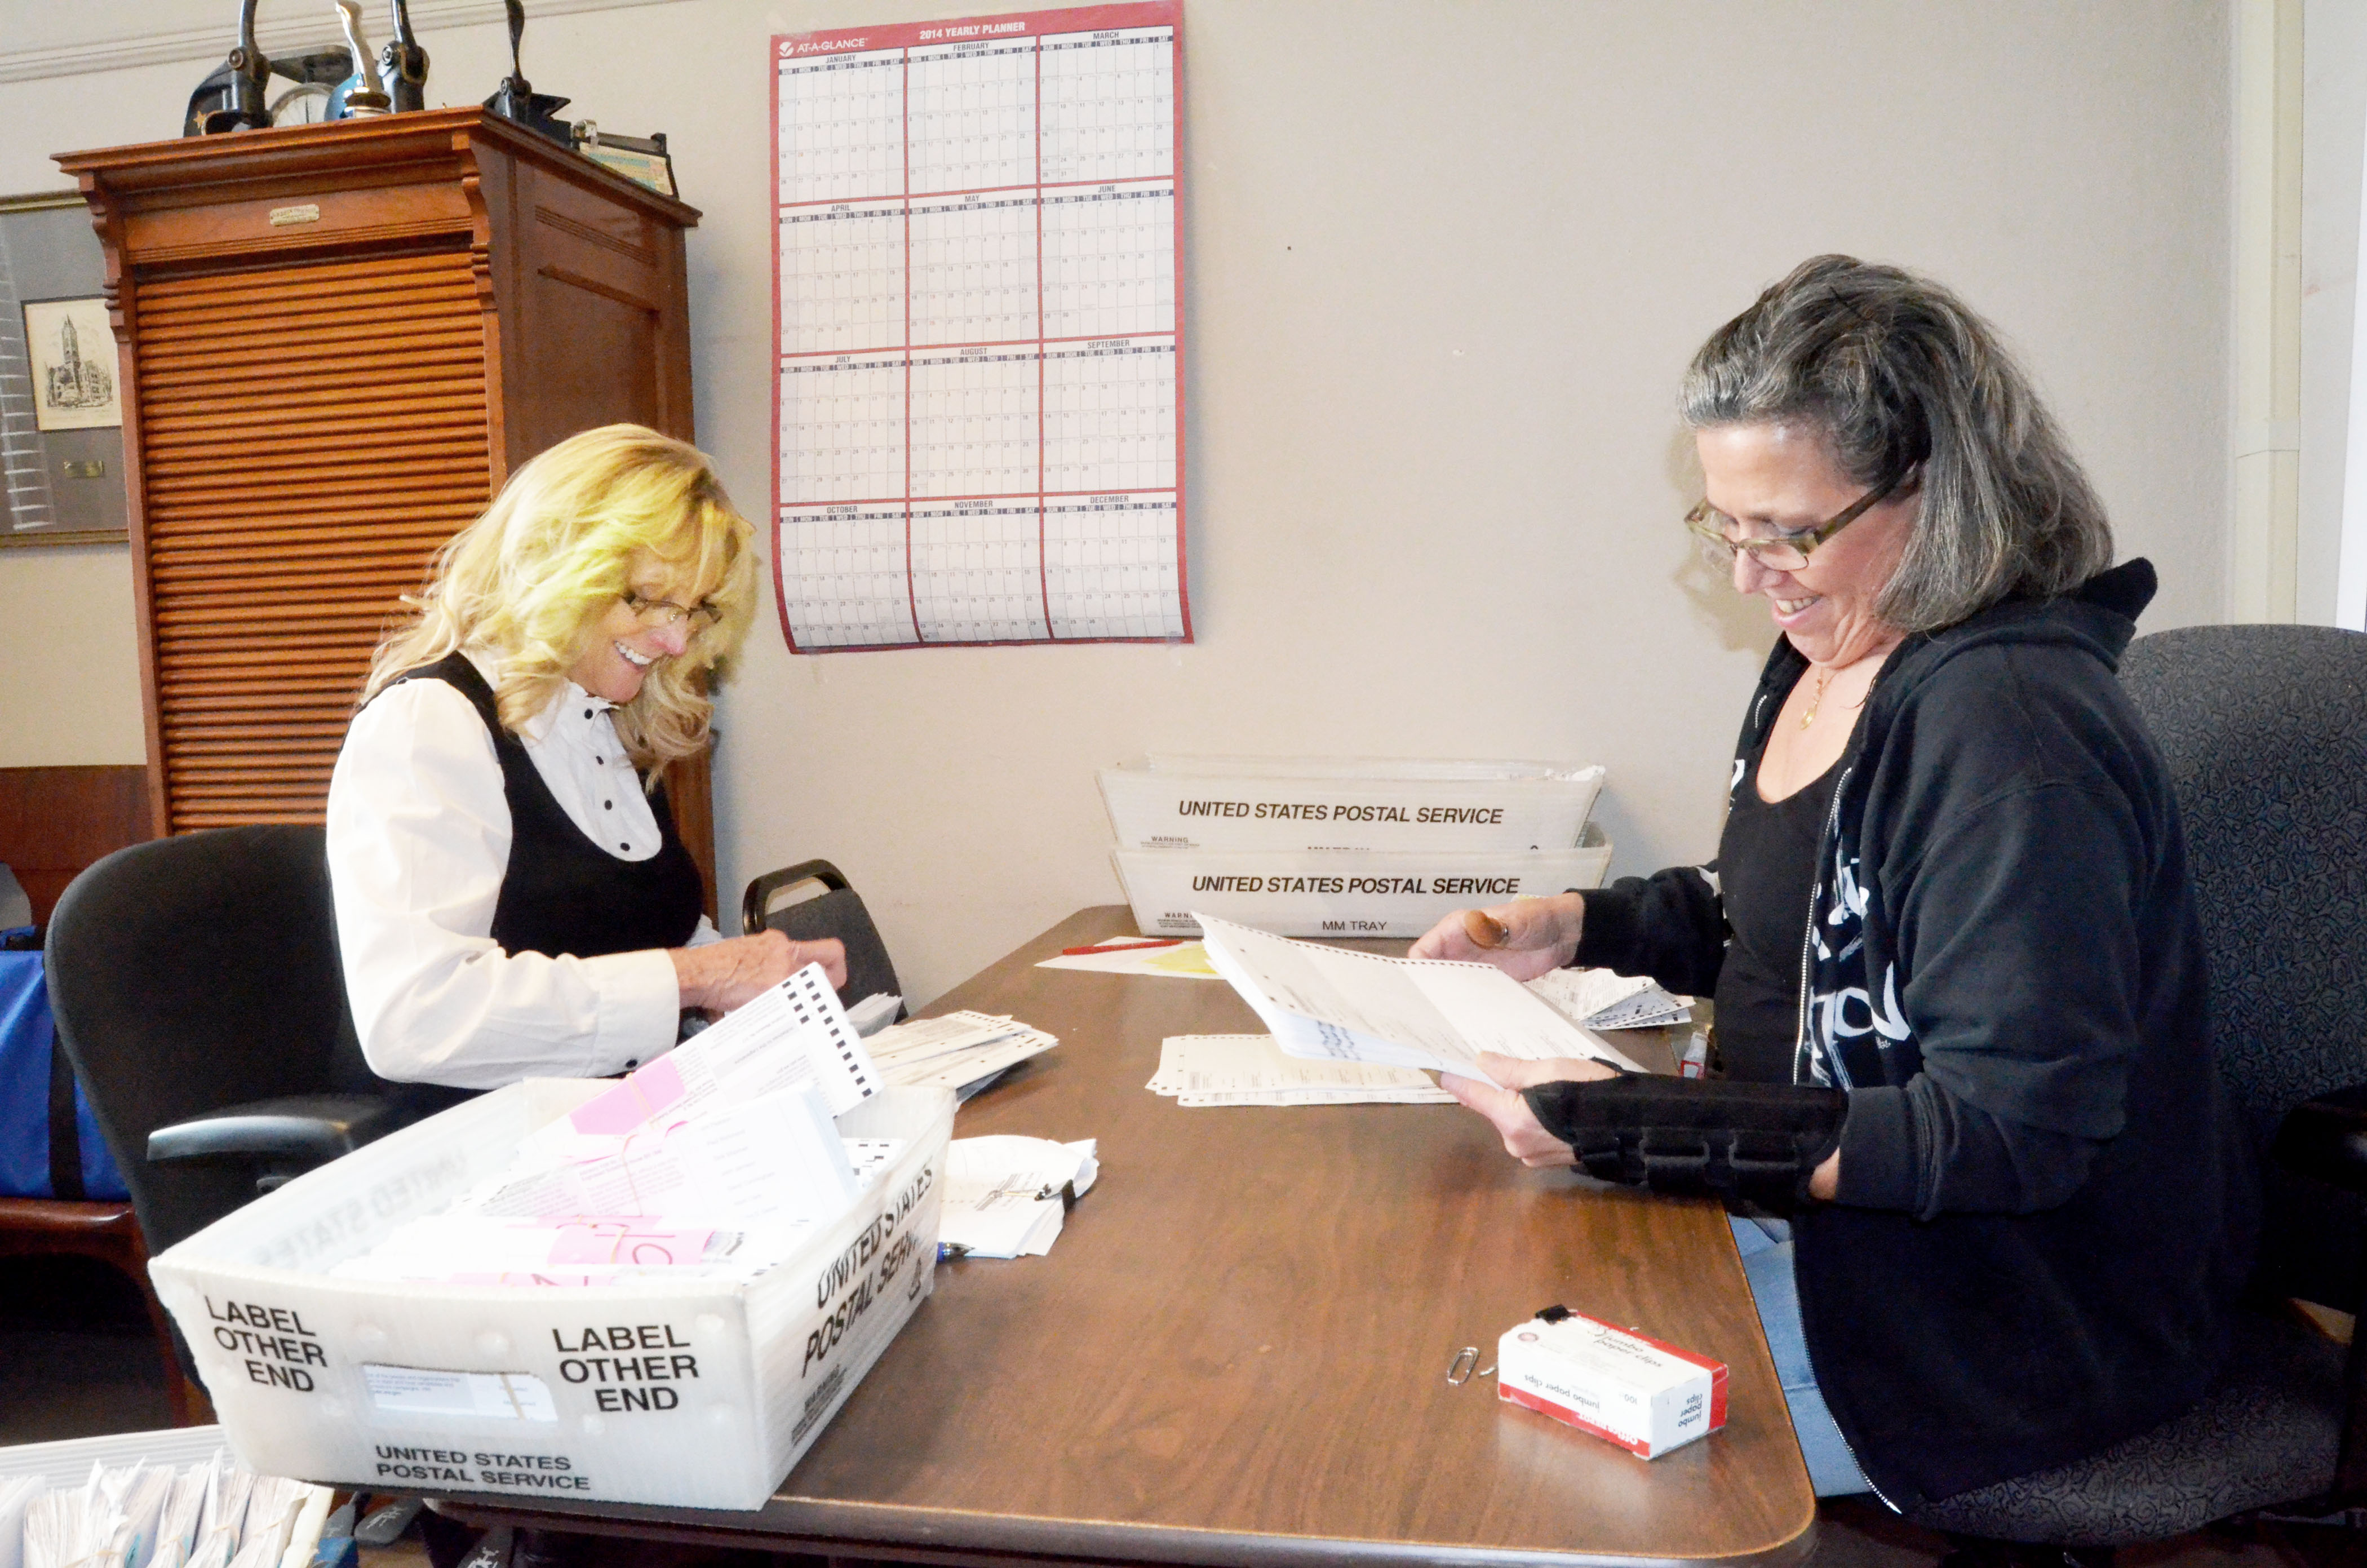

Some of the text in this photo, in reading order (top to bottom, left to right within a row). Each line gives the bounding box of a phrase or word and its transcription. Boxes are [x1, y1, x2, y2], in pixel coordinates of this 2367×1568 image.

[920, 22, 1025, 40] 2014 YEARLY PLANNER
[797, 38, 865, 54] AT-A-GLANCE
[954, 42, 989, 51] FEBRUARY
[825, 54, 856, 63] JANUARY
[1088, 340, 1129, 348] SEPTEMBER
[1178, 800, 1504, 824] UNITED STATES POSTAL SERVICE
[1192, 876, 1520, 894] UNITED STATES POSTAL SERVICE
[1323, 920, 1387, 931] MM TRAY
[818, 1213, 883, 1309] UNITED
[885, 1163, 932, 1238] STATES
[204, 1295, 316, 1337] LABEL
[802, 1272, 873, 1379] POSTAL
[214, 1326, 328, 1368] OTHER
[552, 1325, 691, 1353] LABEL
[1602, 1335, 1643, 1352] jumbo
[1593, 1339, 1634, 1354] paper
[1635, 1354, 1662, 1368] clips
[245, 1359, 314, 1392] END
[560, 1355, 699, 1384] OTHER
[595, 1387, 679, 1412] END
[1524, 1374, 1600, 1412] jumbo paper clips
[1687, 1393, 1703, 1405] clips
[1678, 1410, 1701, 1428] jumbo
[1680, 1400, 1702, 1417] paper
[375, 1445, 571, 1470] UNITED STATES
[376, 1463, 591, 1491] POSTAL SERVICE
